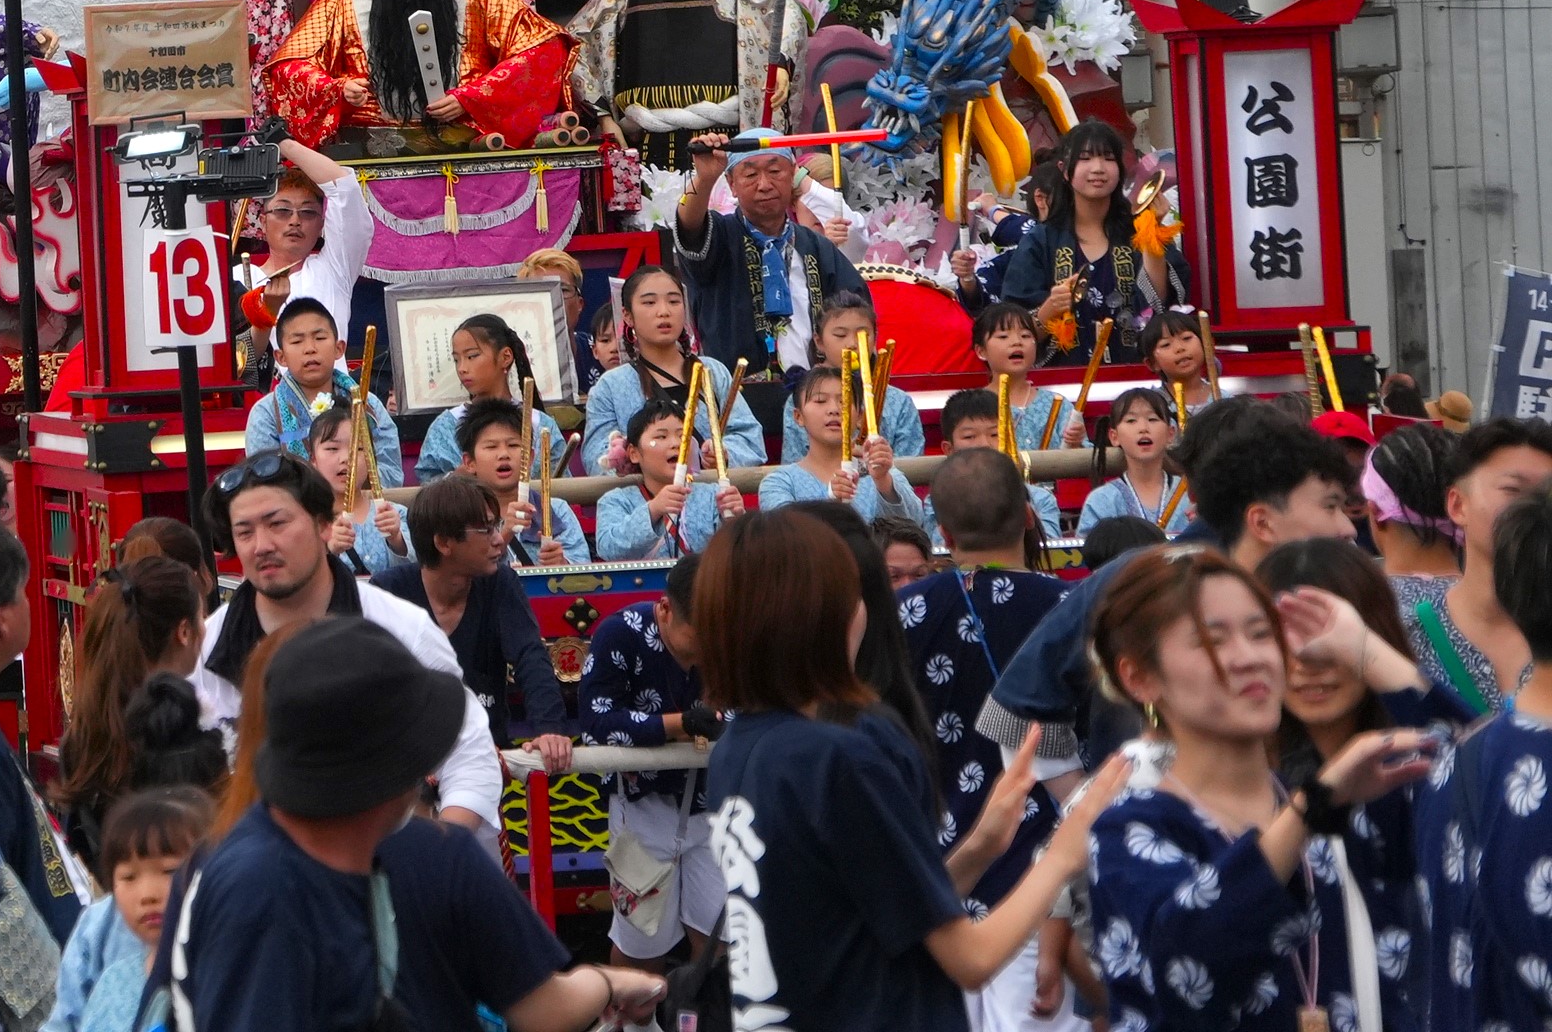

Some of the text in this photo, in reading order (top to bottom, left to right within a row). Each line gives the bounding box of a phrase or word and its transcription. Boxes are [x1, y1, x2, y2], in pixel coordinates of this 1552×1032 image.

[148, 46, 186, 57] 十和田市
[103, 62, 236, 94] 町内会連合会賞
[1240, 80, 1305, 281] 公園街
[1055, 246, 1074, 285] 公園
[149, 238, 216, 336] 13
[1528, 288, 1552, 312] 14
